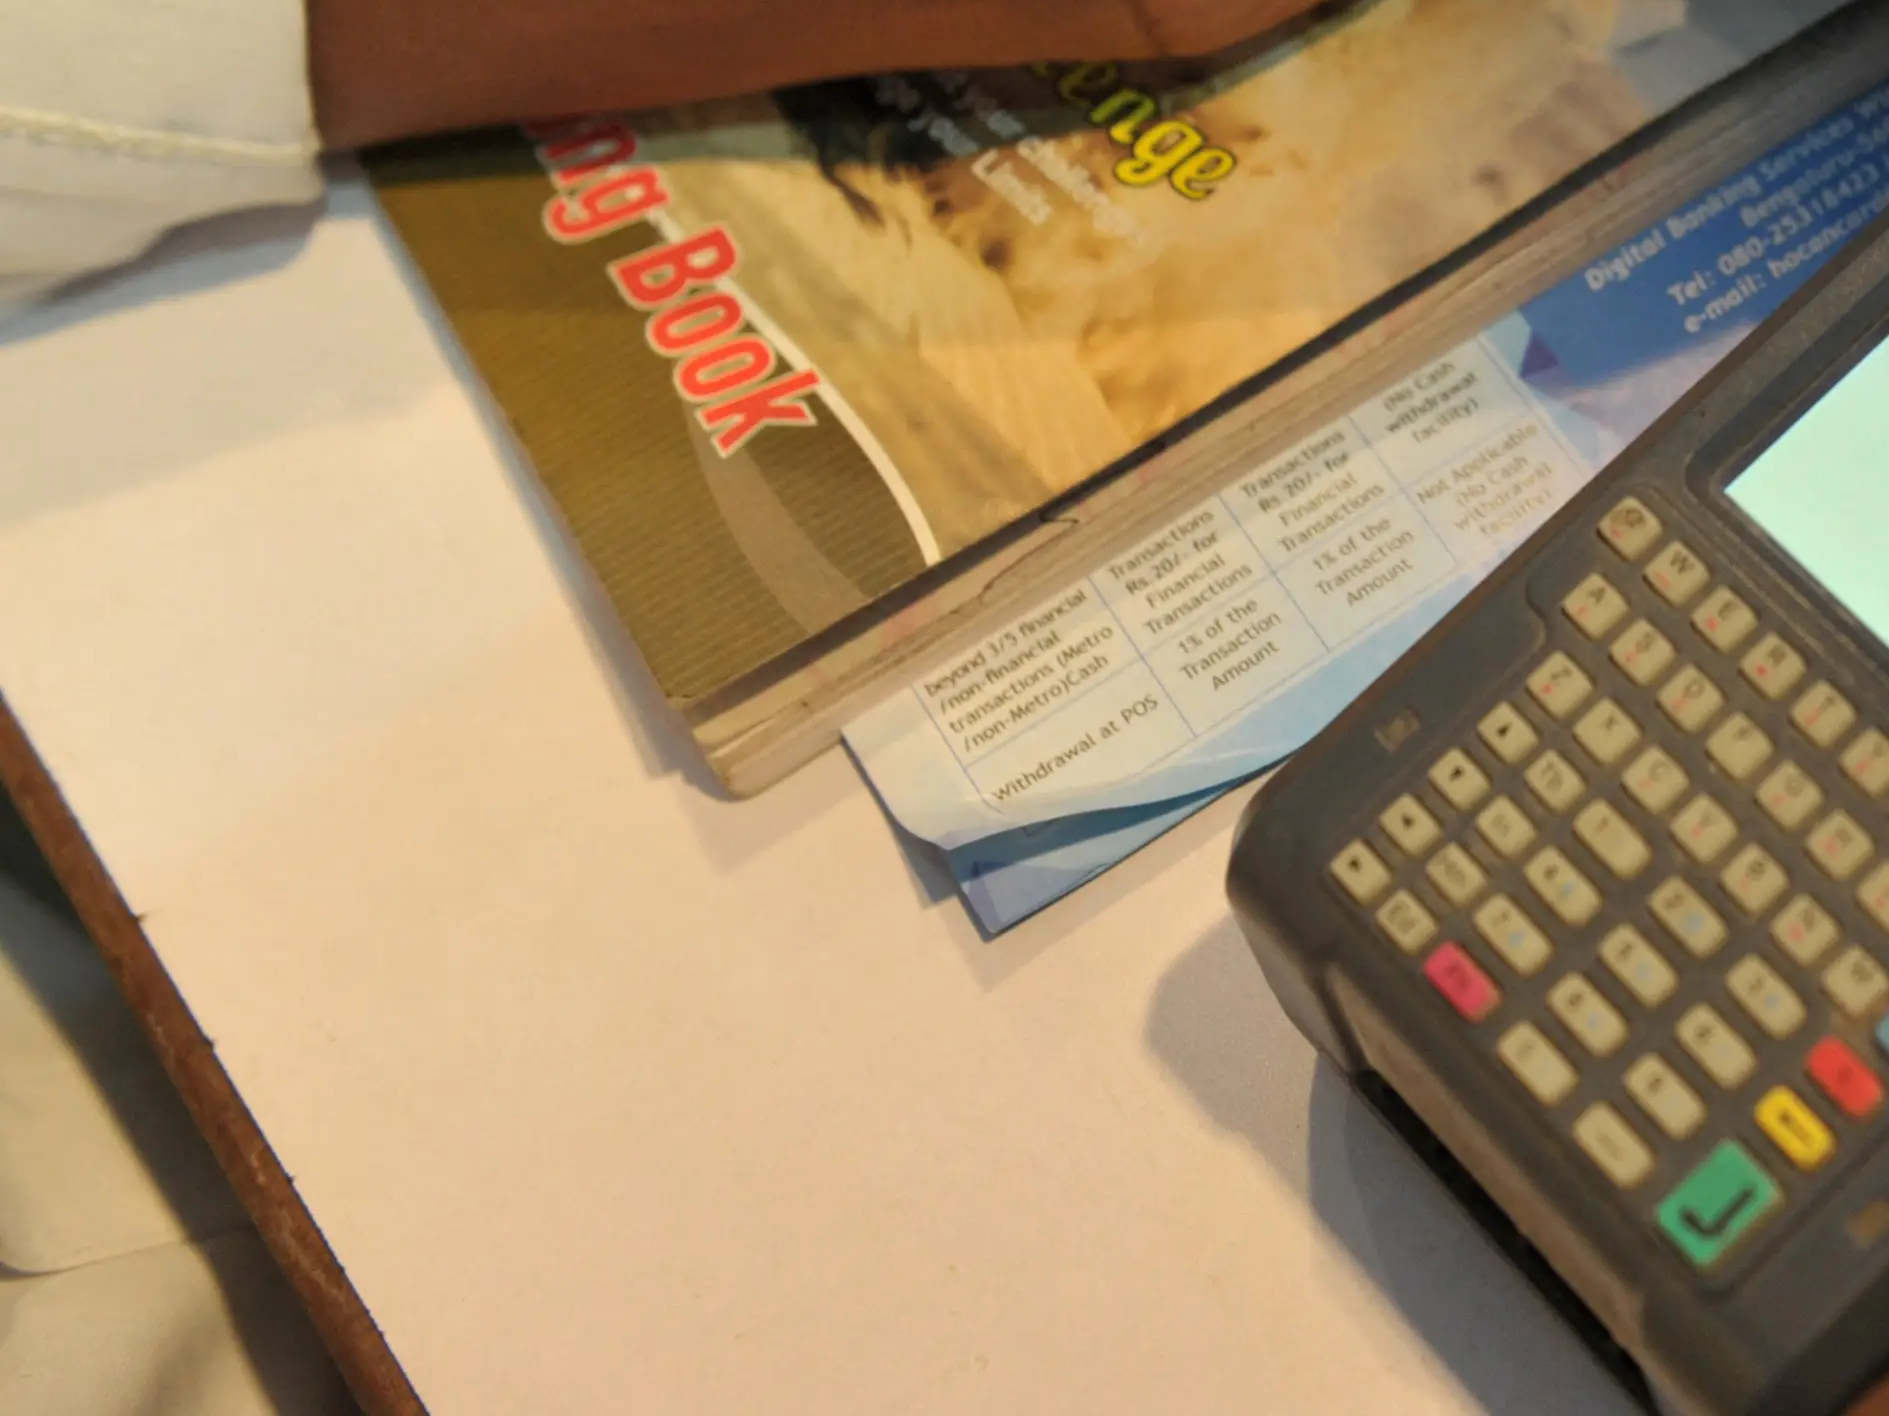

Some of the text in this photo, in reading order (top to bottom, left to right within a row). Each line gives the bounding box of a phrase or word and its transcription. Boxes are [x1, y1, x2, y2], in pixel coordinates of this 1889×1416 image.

[1030, 61, 1237, 201] enge
[1584, 227, 1666, 292] Digital
[1666, 269, 1718, 306] Tel:
[1684, 273, 1766, 333] e-mail:
[606, 222, 820, 459] Book
[1385, 371, 1479, 433] withdrawal
[1413, 361, 1456, 391] Cash
[1240, 431, 1346, 498] Transactions
[1324, 451, 1349, 473] for
[1416, 478, 1451, 505] Not
[1277, 484, 1385, 553] Transactions
[1278, 471, 1358, 527] Financial
[1108, 510, 1214, 580] Transactions
[1192, 531, 1219, 552] for
[1315, 530, 1415, 596] Transaction
[1338, 536, 1358, 557] of
[1360, 518, 1391, 542] the
[1142, 563, 1253, 635] Transactions
[1144, 552, 1226, 610] Financial
[1347, 558, 1414, 608] Amount
[924, 650, 987, 698] beyond
[1018, 588, 1087, 637] financial
[1179, 611, 1282, 680] Transaction
[1205, 617, 1224, 638] of
[1226, 599, 1258, 624] the
[939, 630, 1062, 715] /non-financial
[949, 626, 1114, 734] transactions (Metro
[1211, 640, 1280, 691] Amount
[992, 694, 1159, 801] Withdrawal at POS
